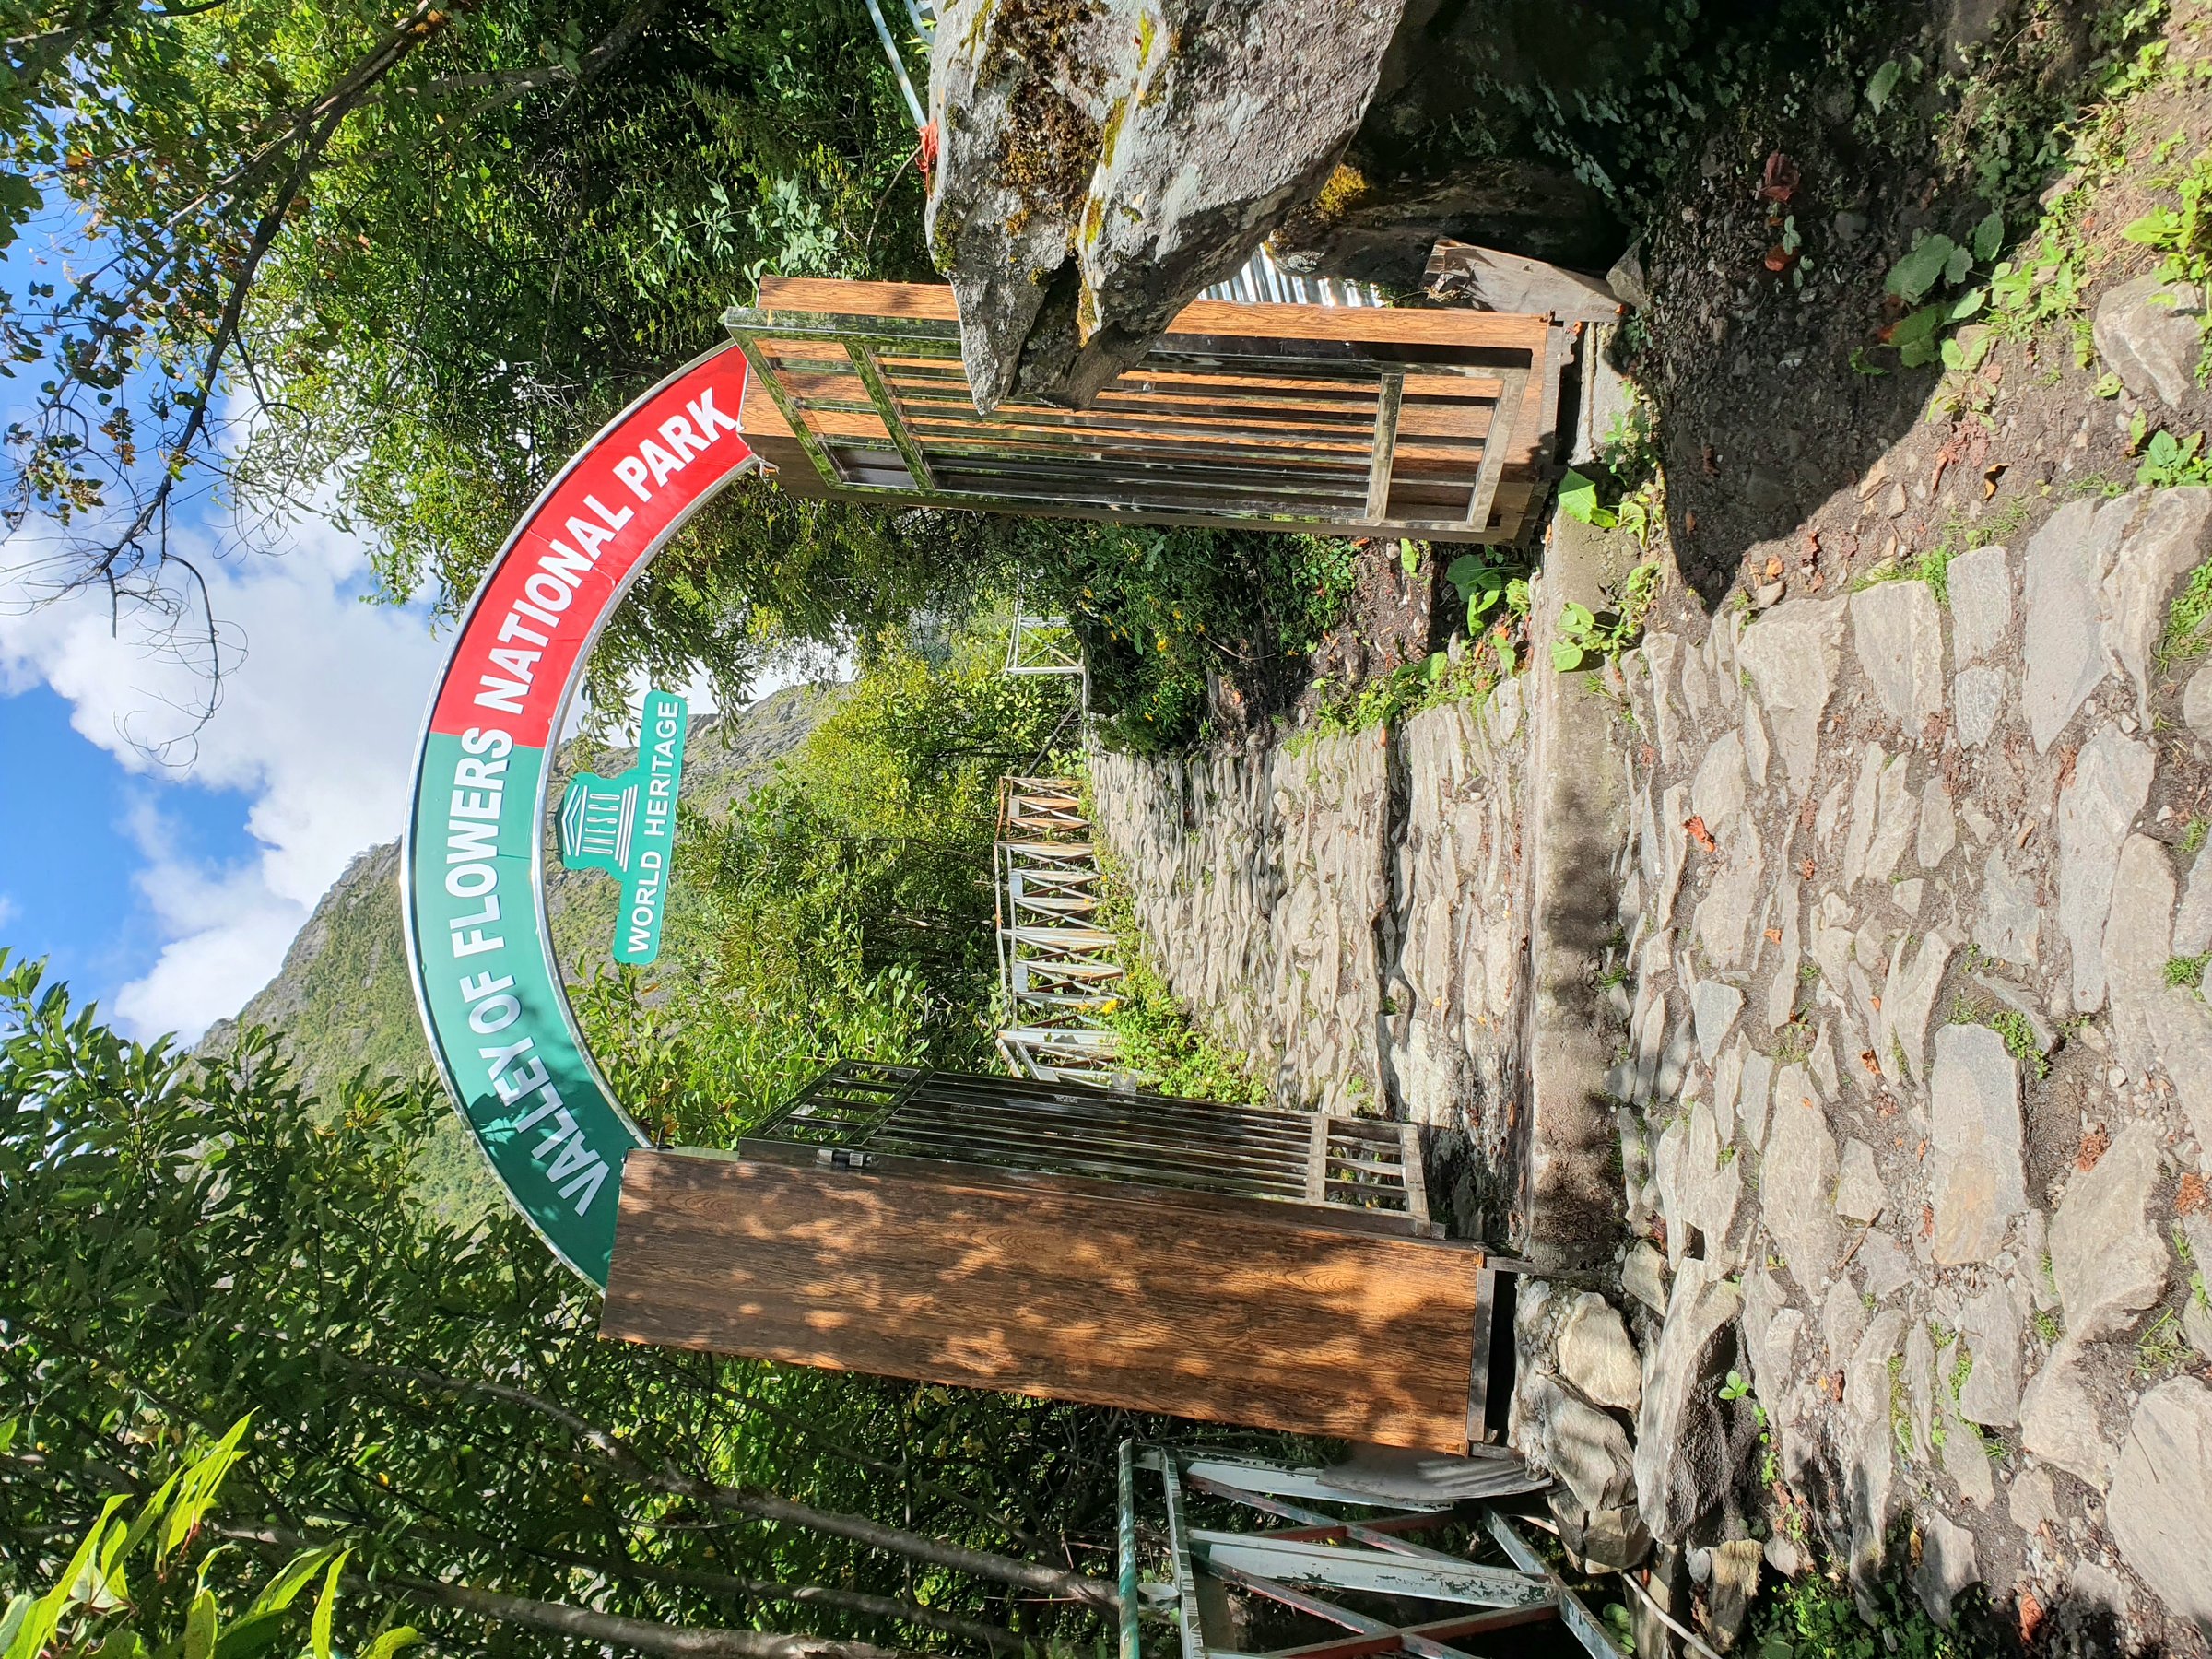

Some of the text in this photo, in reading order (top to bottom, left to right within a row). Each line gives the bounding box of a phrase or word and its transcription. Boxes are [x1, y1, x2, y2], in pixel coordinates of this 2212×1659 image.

[445, 386, 737, 1217] VALLEY OF FLOWERS NATIONAL PARK
[582, 793, 620, 854] UNESCO
[628, 701, 679, 953] WORLD HERITAGE
